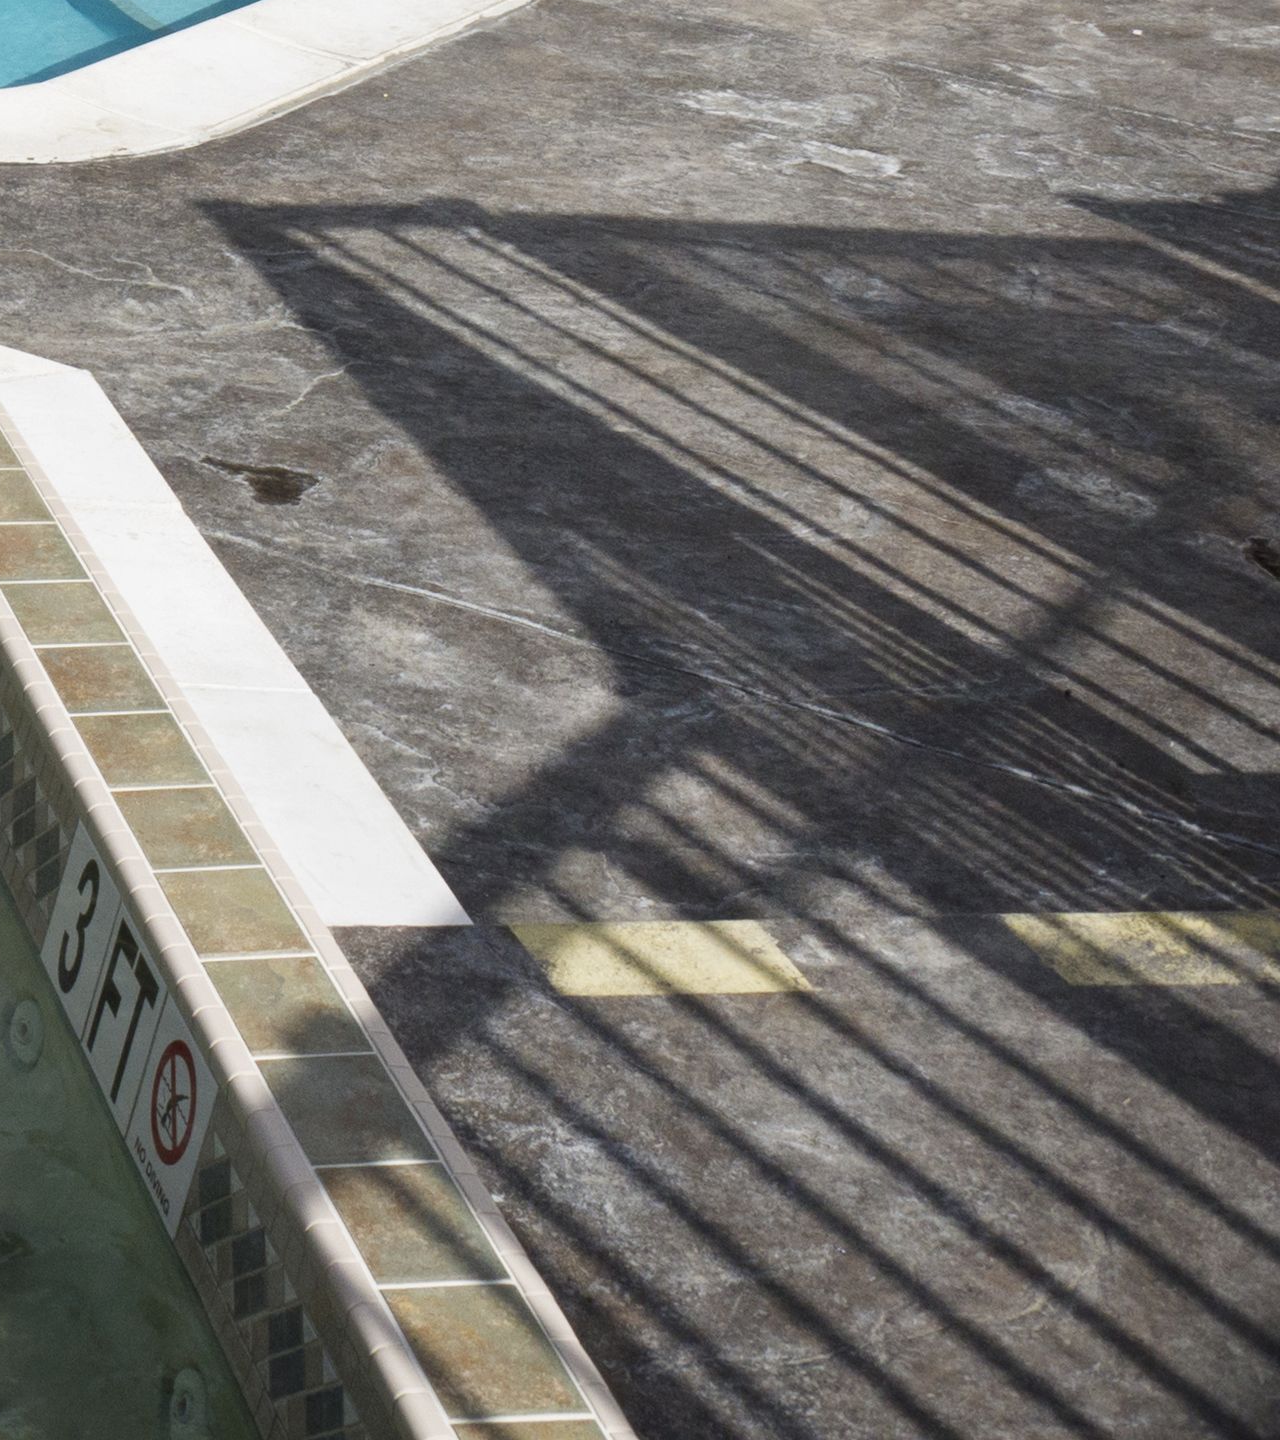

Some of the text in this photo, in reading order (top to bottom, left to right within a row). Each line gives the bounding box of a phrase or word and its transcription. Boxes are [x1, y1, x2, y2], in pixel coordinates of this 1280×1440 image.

[58, 859, 159, 1104] 3 FT
[134, 1136, 170, 1216] NO DIVING
